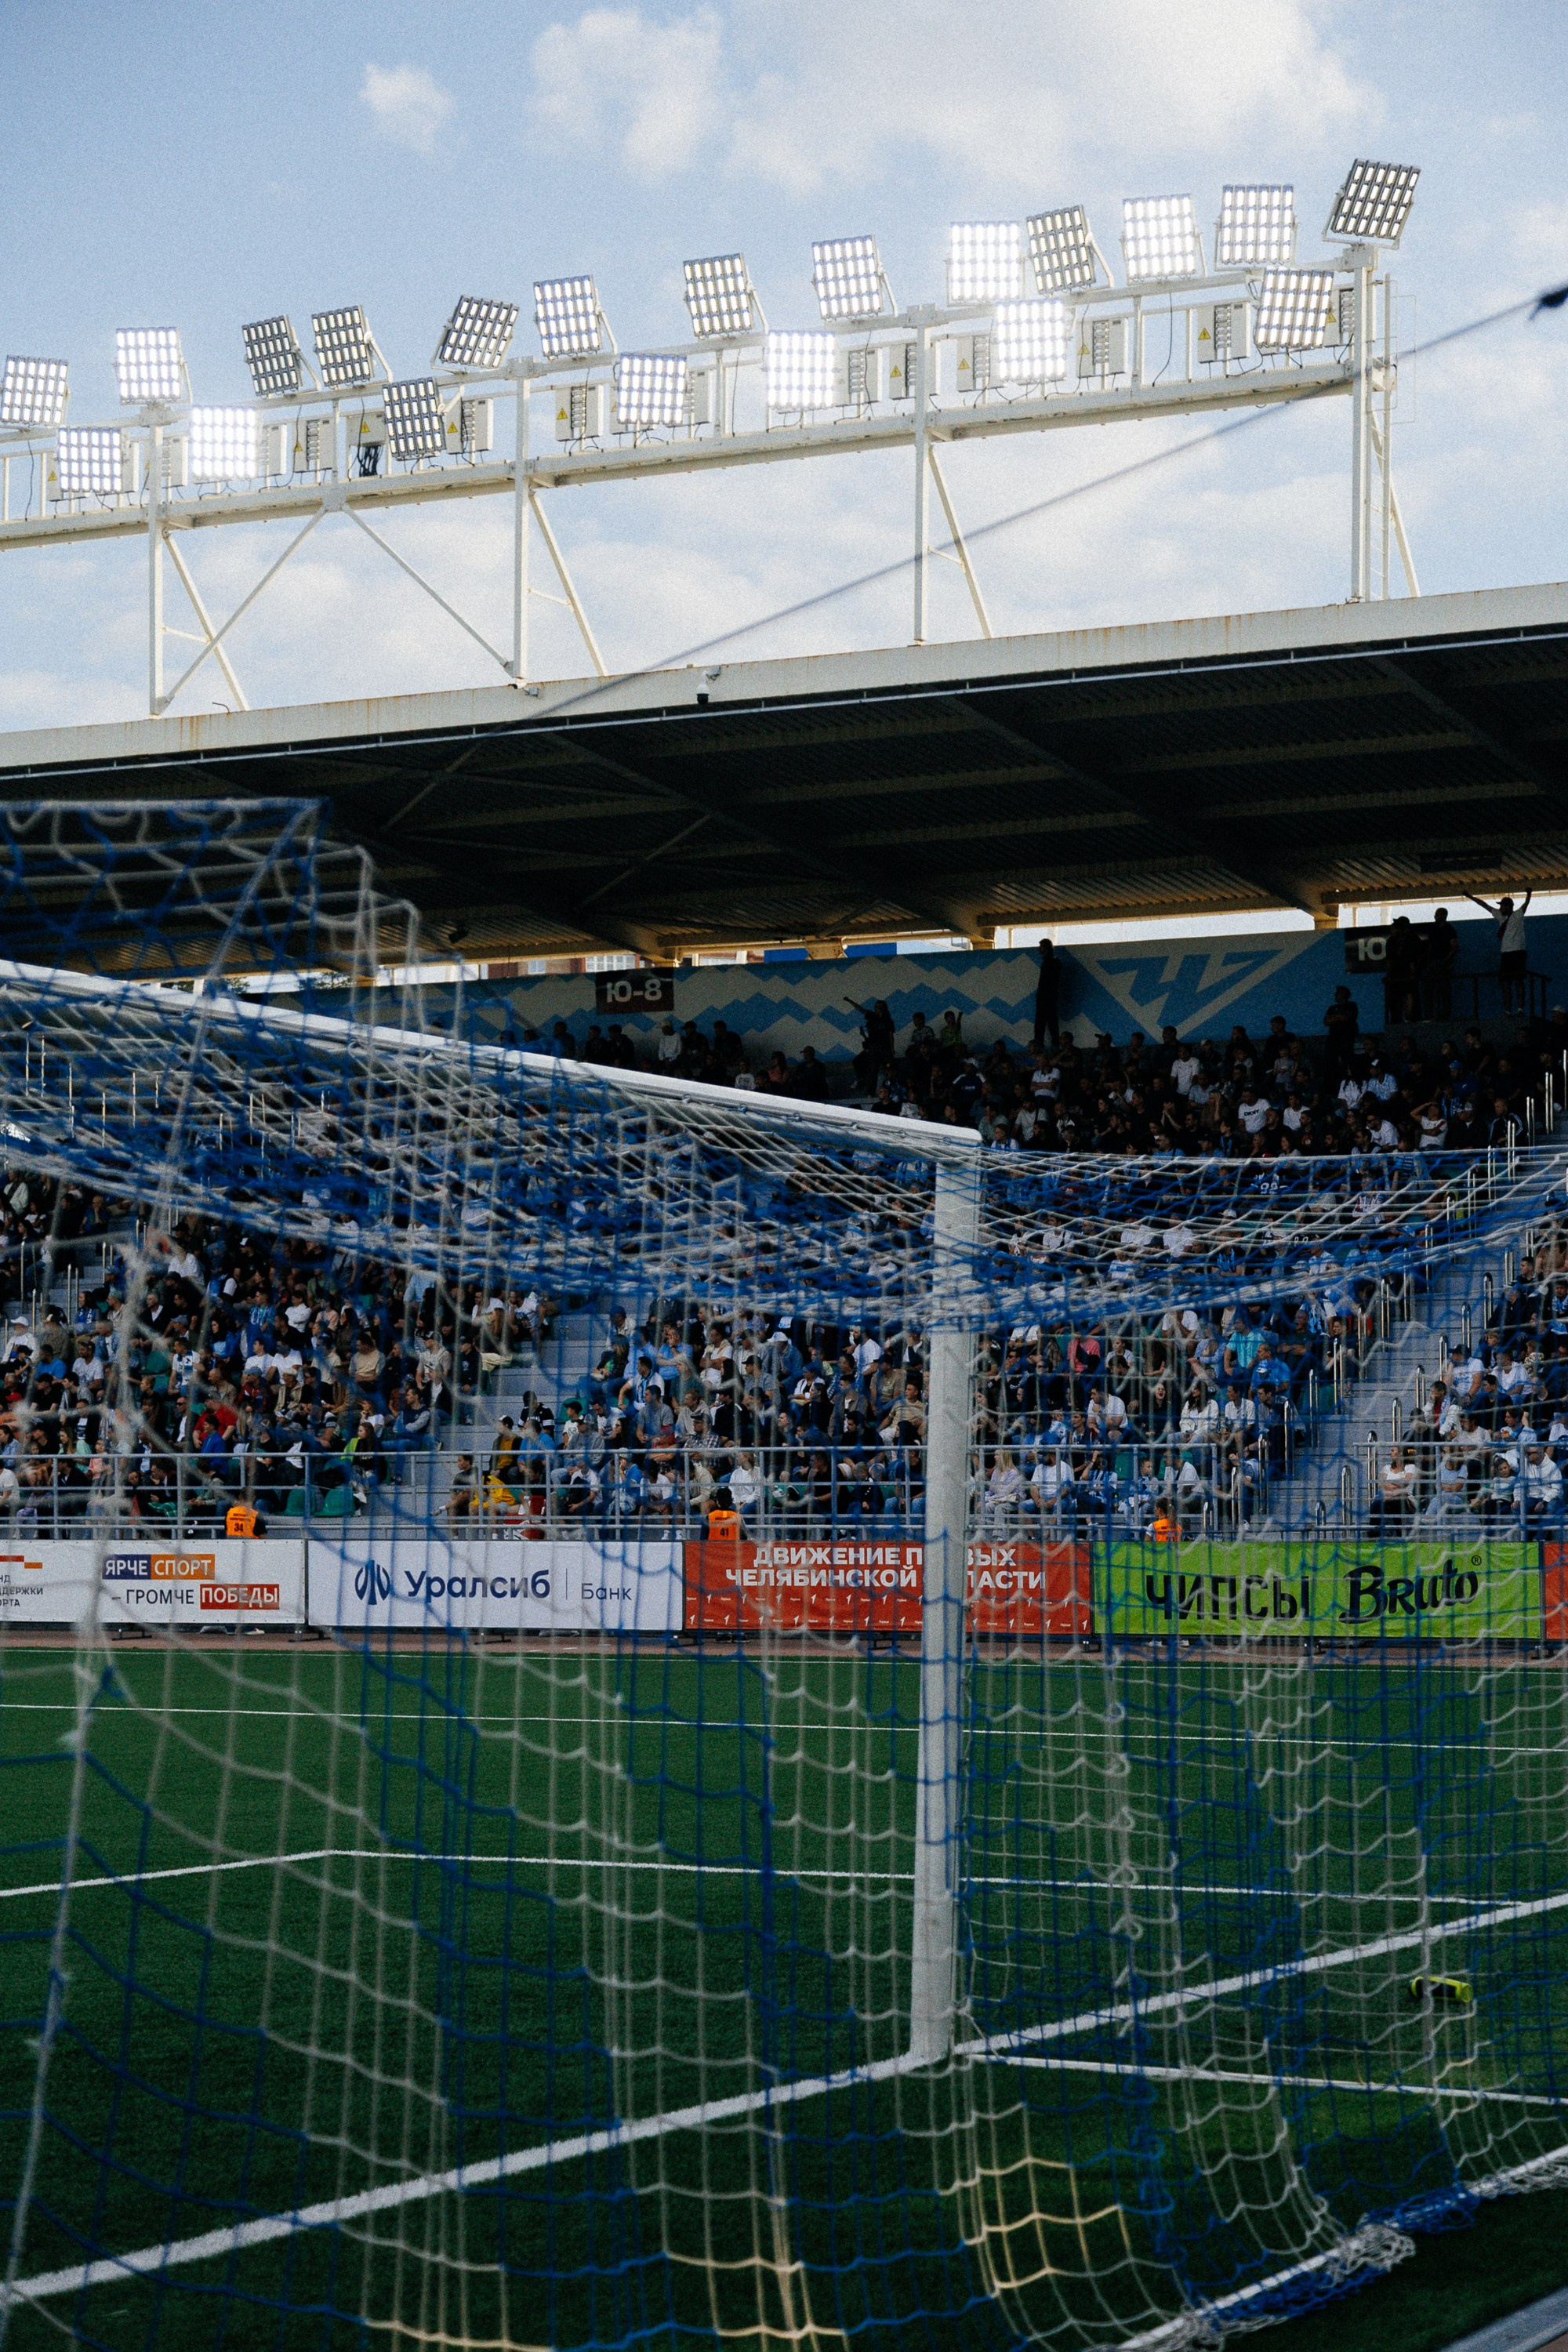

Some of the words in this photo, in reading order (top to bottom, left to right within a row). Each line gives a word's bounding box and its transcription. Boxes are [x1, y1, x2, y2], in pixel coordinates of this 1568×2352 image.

[720, 1527, 729, 1537] 41
[105, 1558, 148, 1575] ЯРЧЕ
[154, 1557, 212, 1576] СПОРТ
[753, 1547, 901, 1568] ДВИЖЕНИЕ
[405, 1569, 550, 1603] Уралсиб
[581, 1582, 632, 1601] Банк
[726, 1564, 917, 1588] ЧЕЛЯБИНСКОЙ
[0, 1587, 44, 1596] ДЕРЖКИ
[126, 1588, 194, 1605] ГРОМЧЕ
[201, 1587, 279, 1607] ПОБЕДЫ
[1145, 1574, 1309, 1621] ЧИПСЫ
